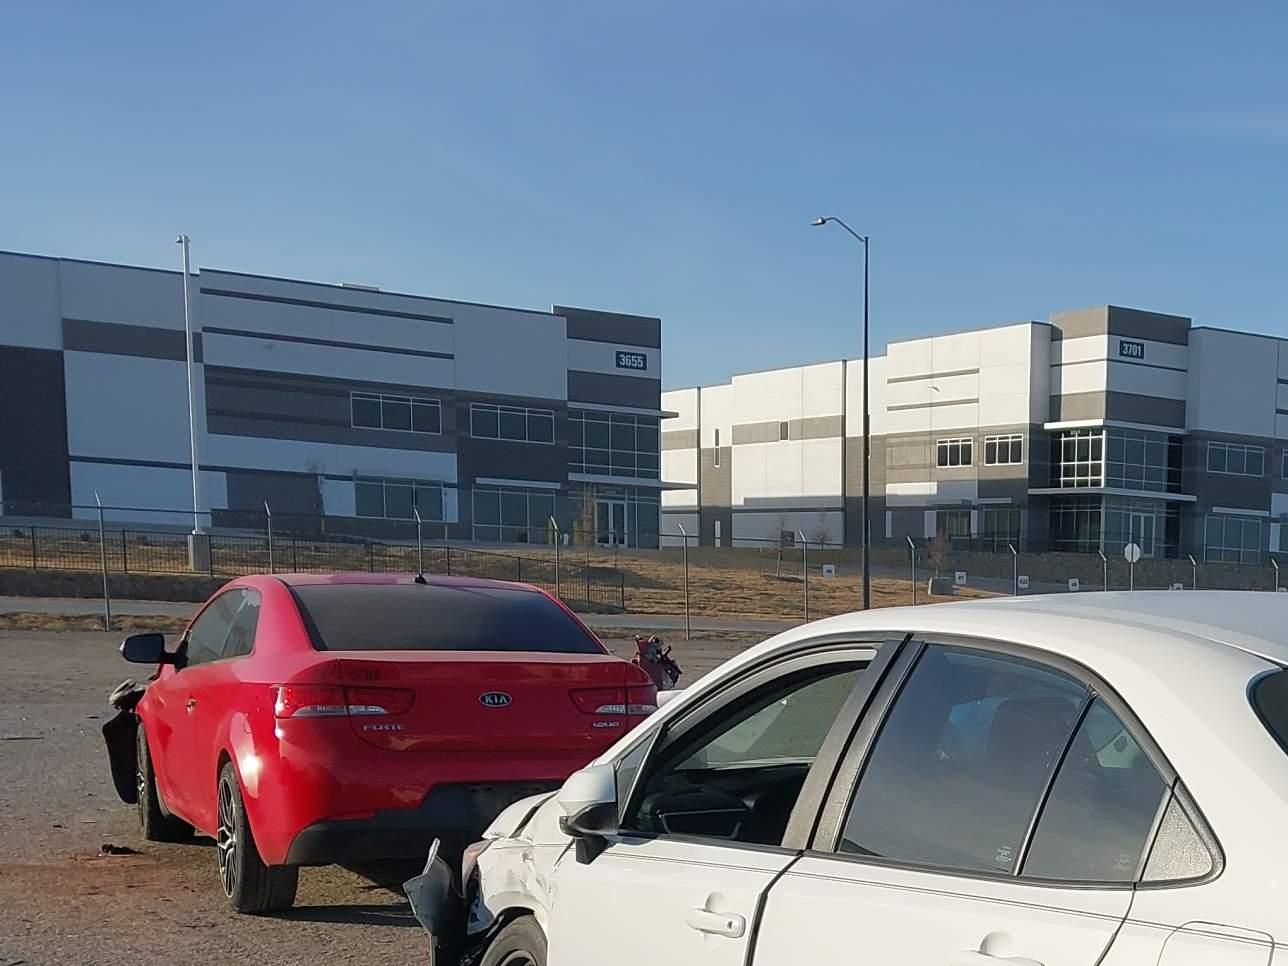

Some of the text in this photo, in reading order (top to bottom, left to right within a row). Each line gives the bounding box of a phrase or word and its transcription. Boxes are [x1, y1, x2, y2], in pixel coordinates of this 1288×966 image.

[1122, 343, 1142, 357] 3701
[619, 353, 644, 367] 3655
[485, 694, 508, 704] KIA
